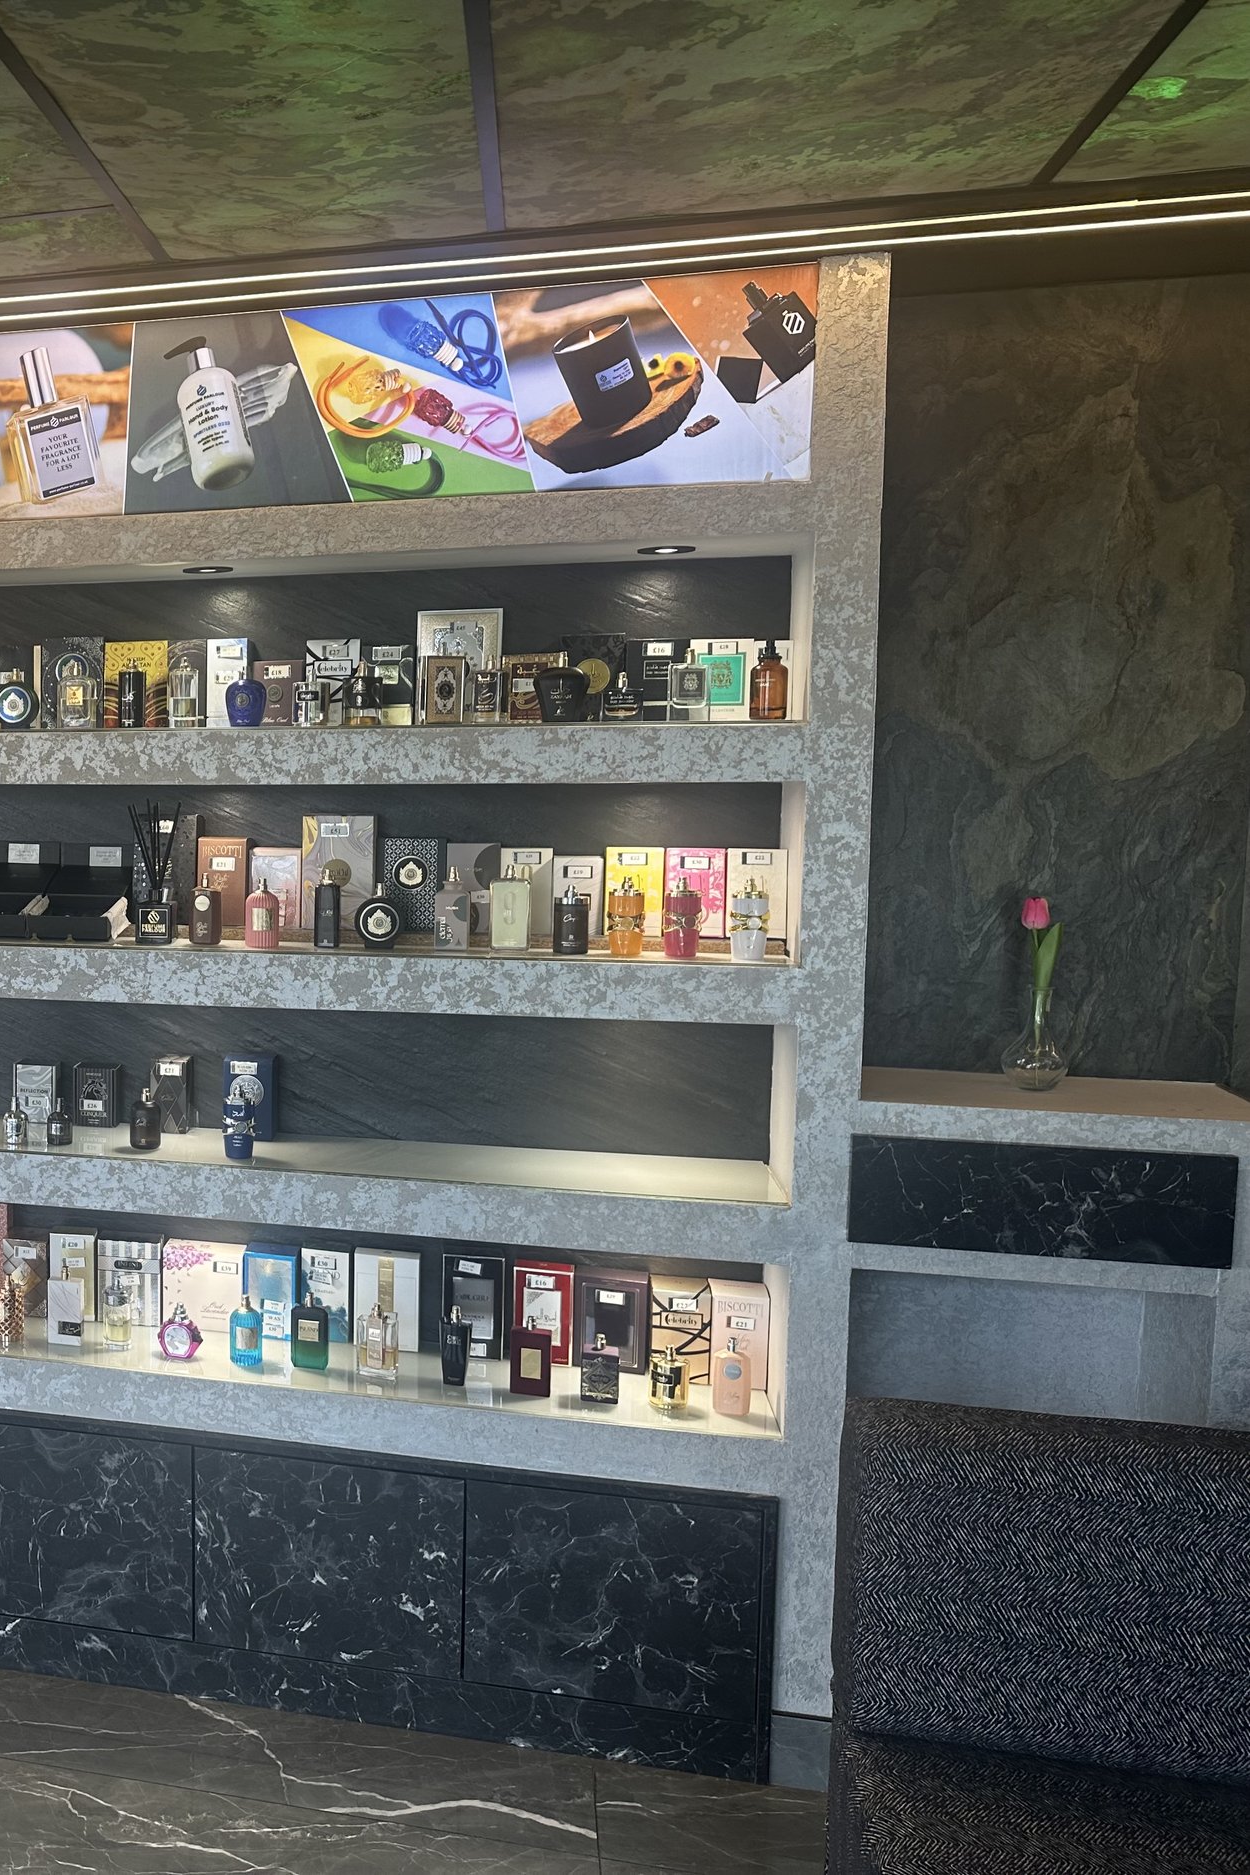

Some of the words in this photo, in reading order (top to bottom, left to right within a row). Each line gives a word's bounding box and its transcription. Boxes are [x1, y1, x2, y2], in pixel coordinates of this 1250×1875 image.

[188, 411, 204, 425] Hand
[210, 404, 228, 413] Body
[198, 414, 219, 426] Lotion
[30, 421, 50, 432] PERFUME
[59, 414, 79, 423] PARLOUR
[48, 433, 68, 443] YOUR
[40, 438, 79, 454] FAVOURITE
[41, 445, 81, 461] FRAGRANCE
[46, 459, 60, 468] FOR
[66, 453, 80, 462] LOT
[56, 463, 73, 473] LESS
[317, 661, 348, 673] Celebrity
[202, 845, 242, 859] BISCOTTI
[718, 1299, 764, 1317] BISCOTTI
[664, 1311, 697, 1326] Celebrity
